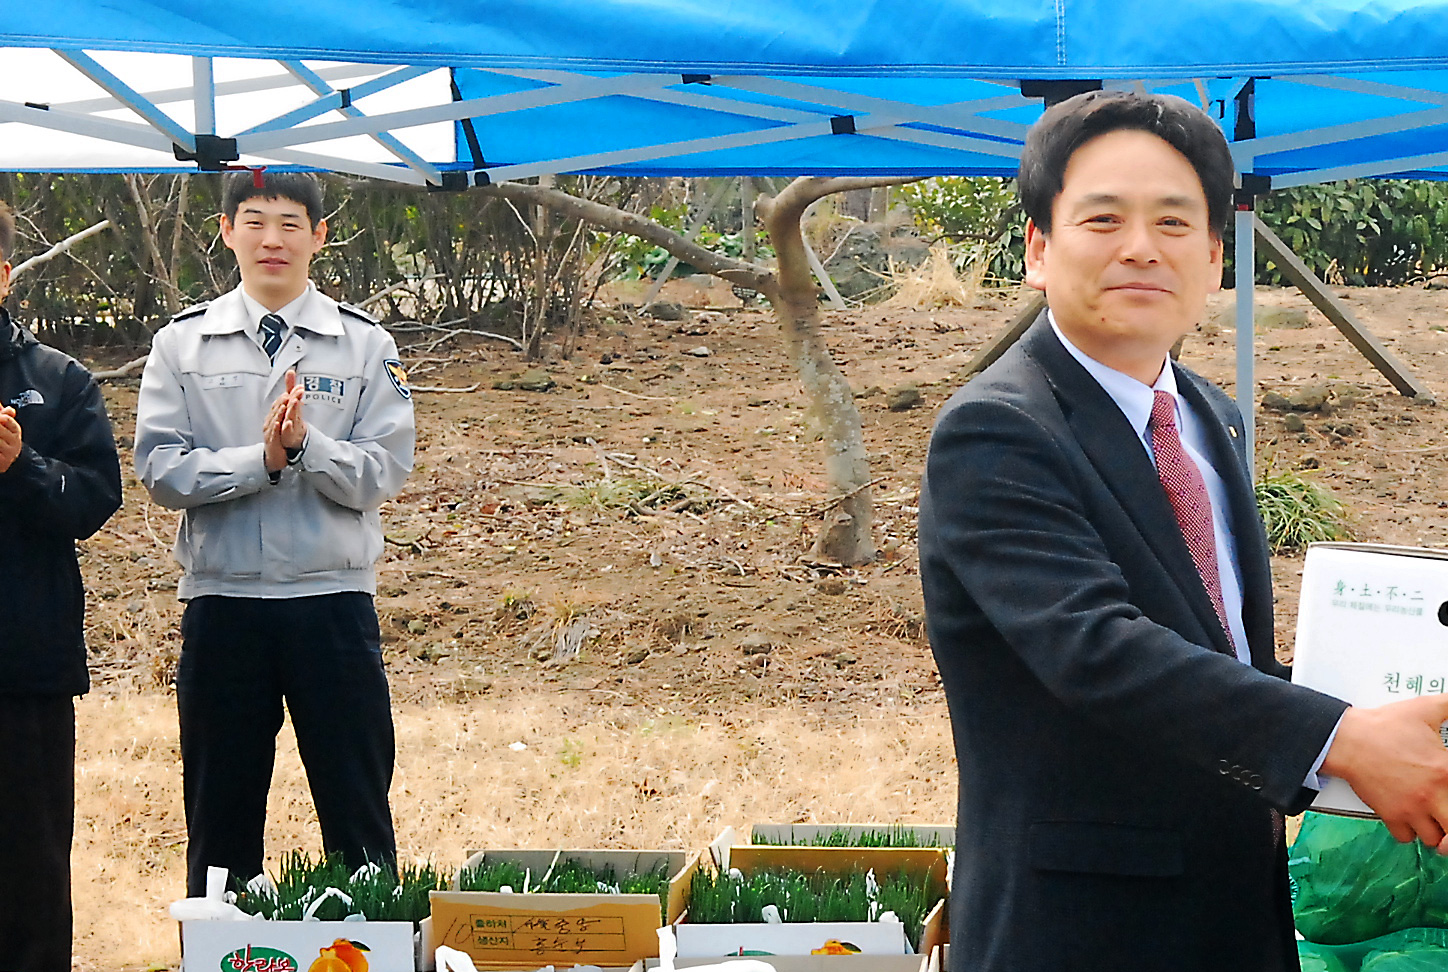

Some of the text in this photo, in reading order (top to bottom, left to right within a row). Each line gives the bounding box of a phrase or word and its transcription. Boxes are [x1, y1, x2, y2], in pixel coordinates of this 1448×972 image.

[305, 393, 342, 404] POLICE
[1384, 671, 1445, 696] 천혜의
[475, 918, 507, 929] 출하처
